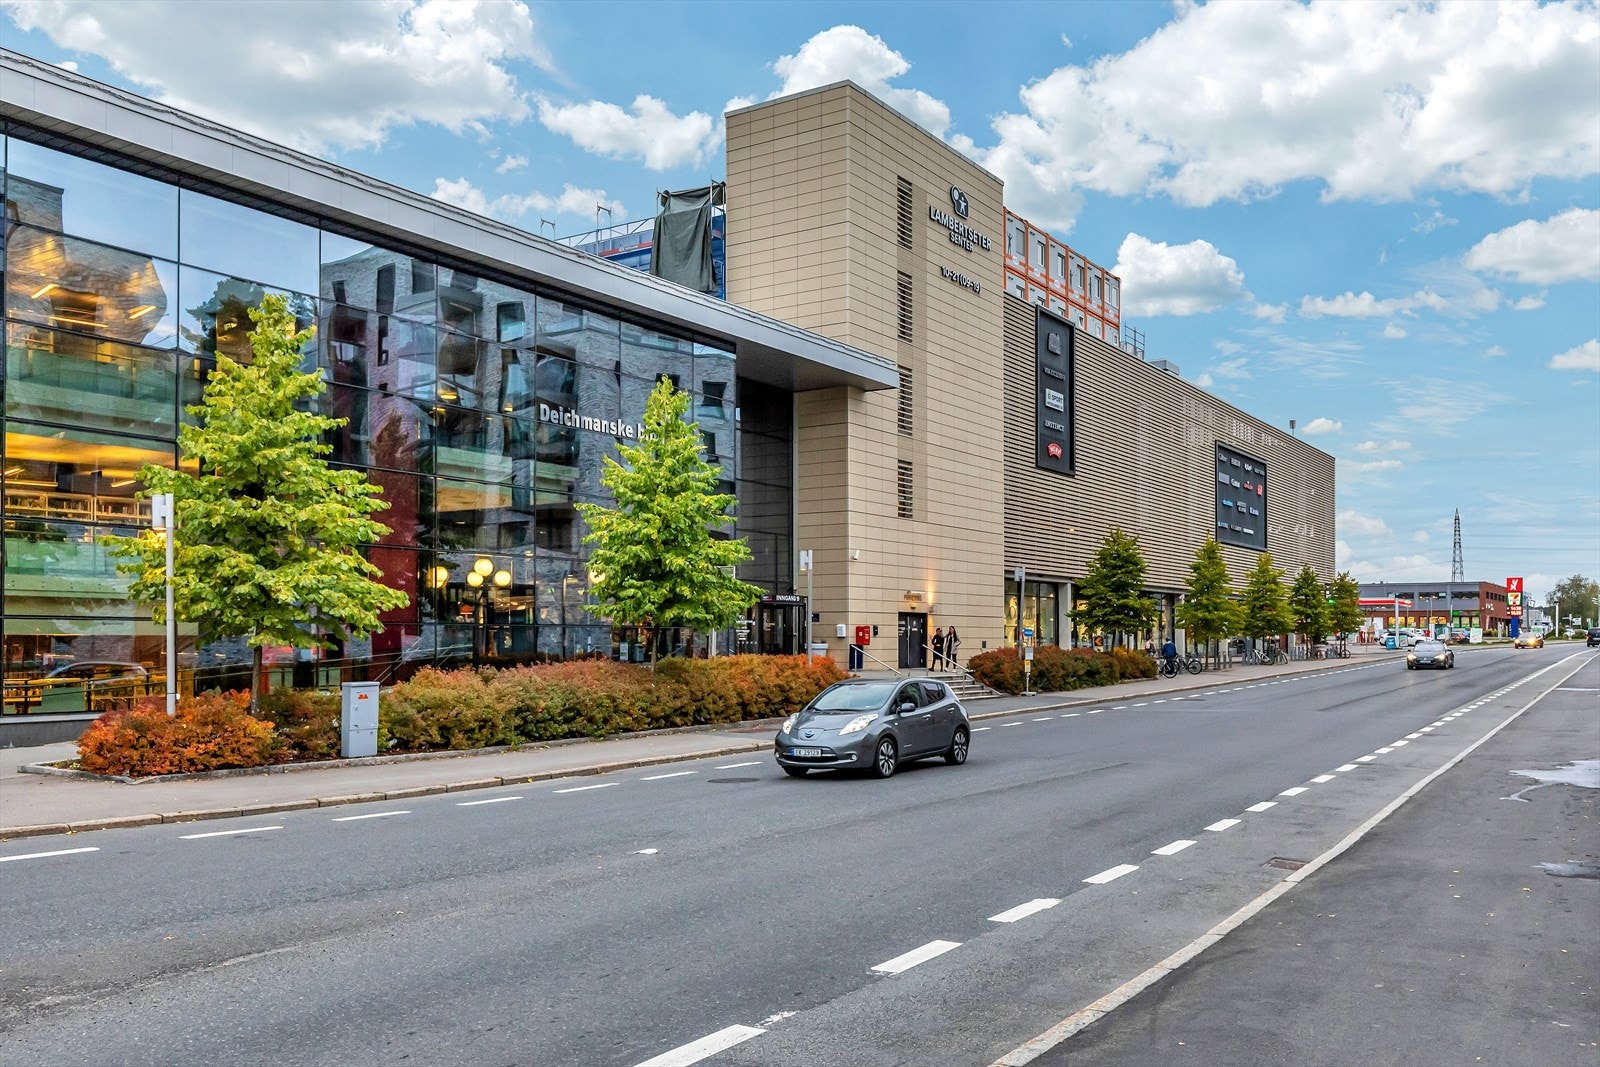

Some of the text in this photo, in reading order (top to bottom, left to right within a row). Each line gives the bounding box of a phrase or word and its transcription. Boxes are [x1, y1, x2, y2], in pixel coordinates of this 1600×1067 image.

[929, 205, 992, 251] LAMBERTSETER
[949, 231, 974, 252] SENTER
[539, 403, 634, 438] Deichmanske
